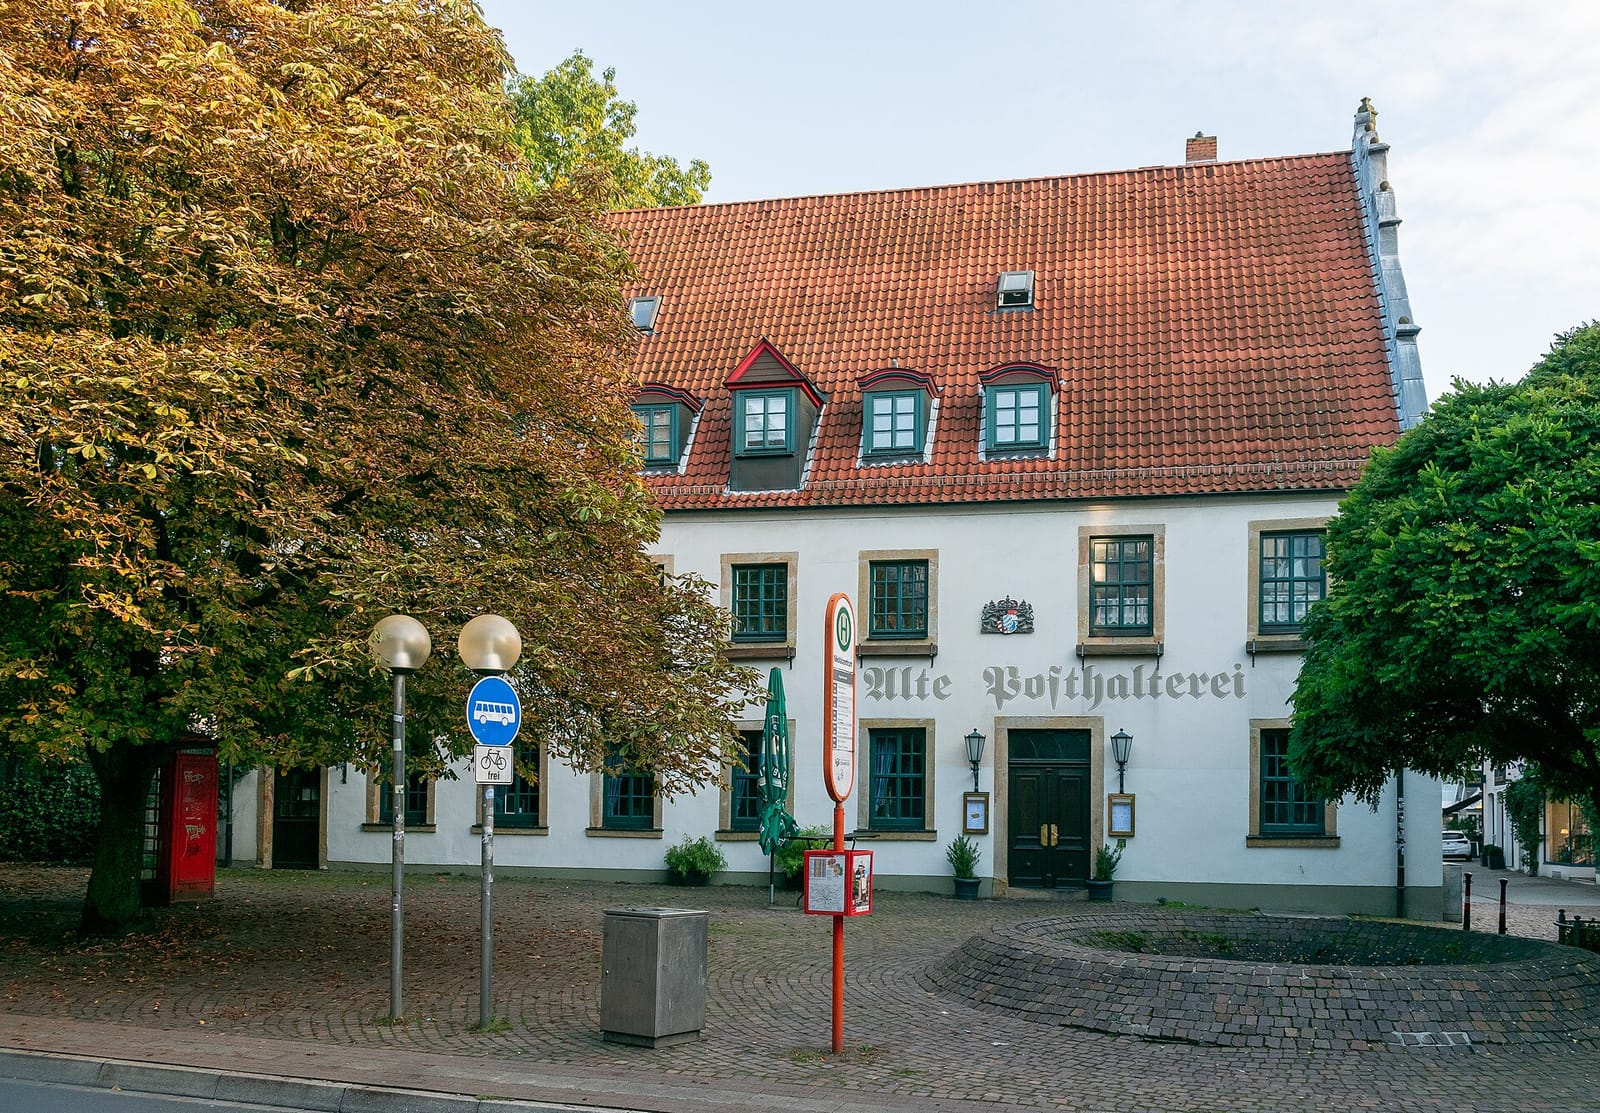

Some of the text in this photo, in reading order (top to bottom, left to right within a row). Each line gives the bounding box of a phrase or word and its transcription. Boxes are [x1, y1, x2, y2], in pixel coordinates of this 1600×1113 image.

[840, 614, 848, 645] H
[864, 667, 953, 701] Alte
[487, 771, 500, 780] frei
